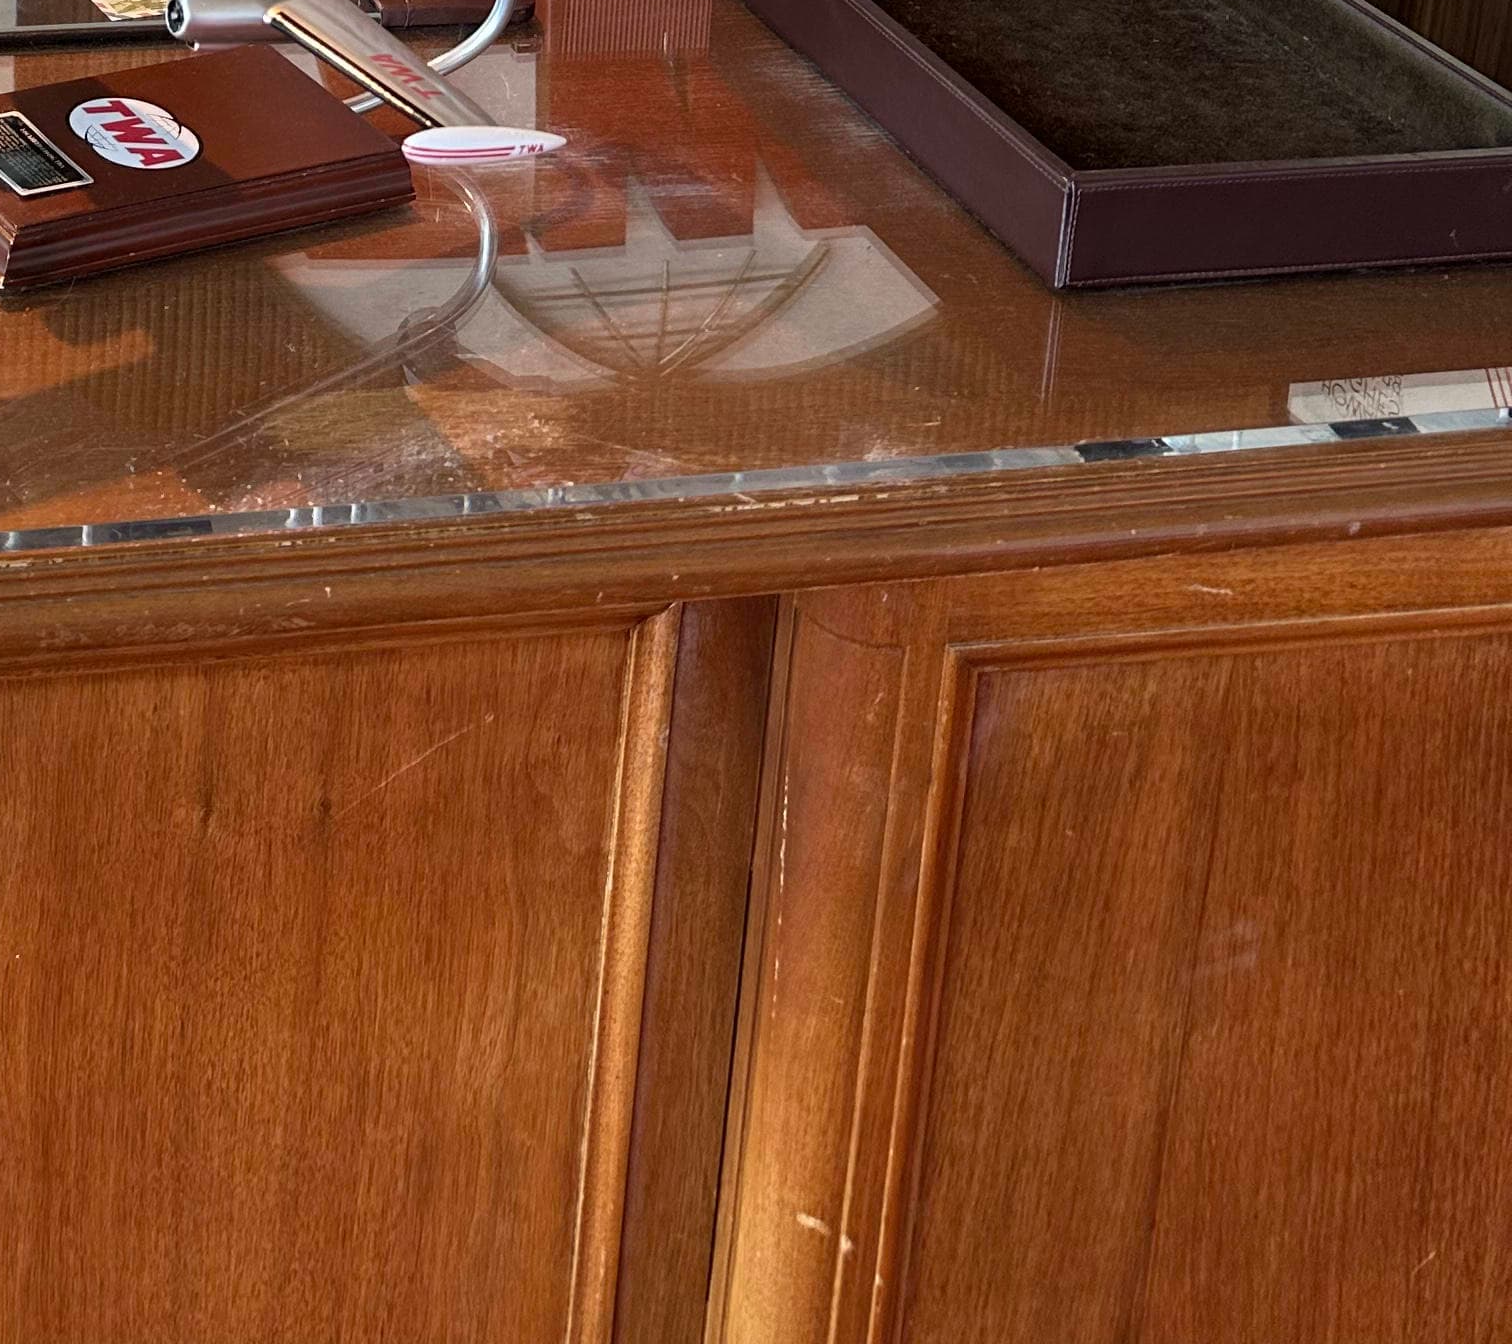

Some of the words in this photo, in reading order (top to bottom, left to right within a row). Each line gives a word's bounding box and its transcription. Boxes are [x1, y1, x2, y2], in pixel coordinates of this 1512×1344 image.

[370, 53, 446, 101] TWA
[82, 100, 185, 166] TWA
[518, 143, 546, 156] TWA
